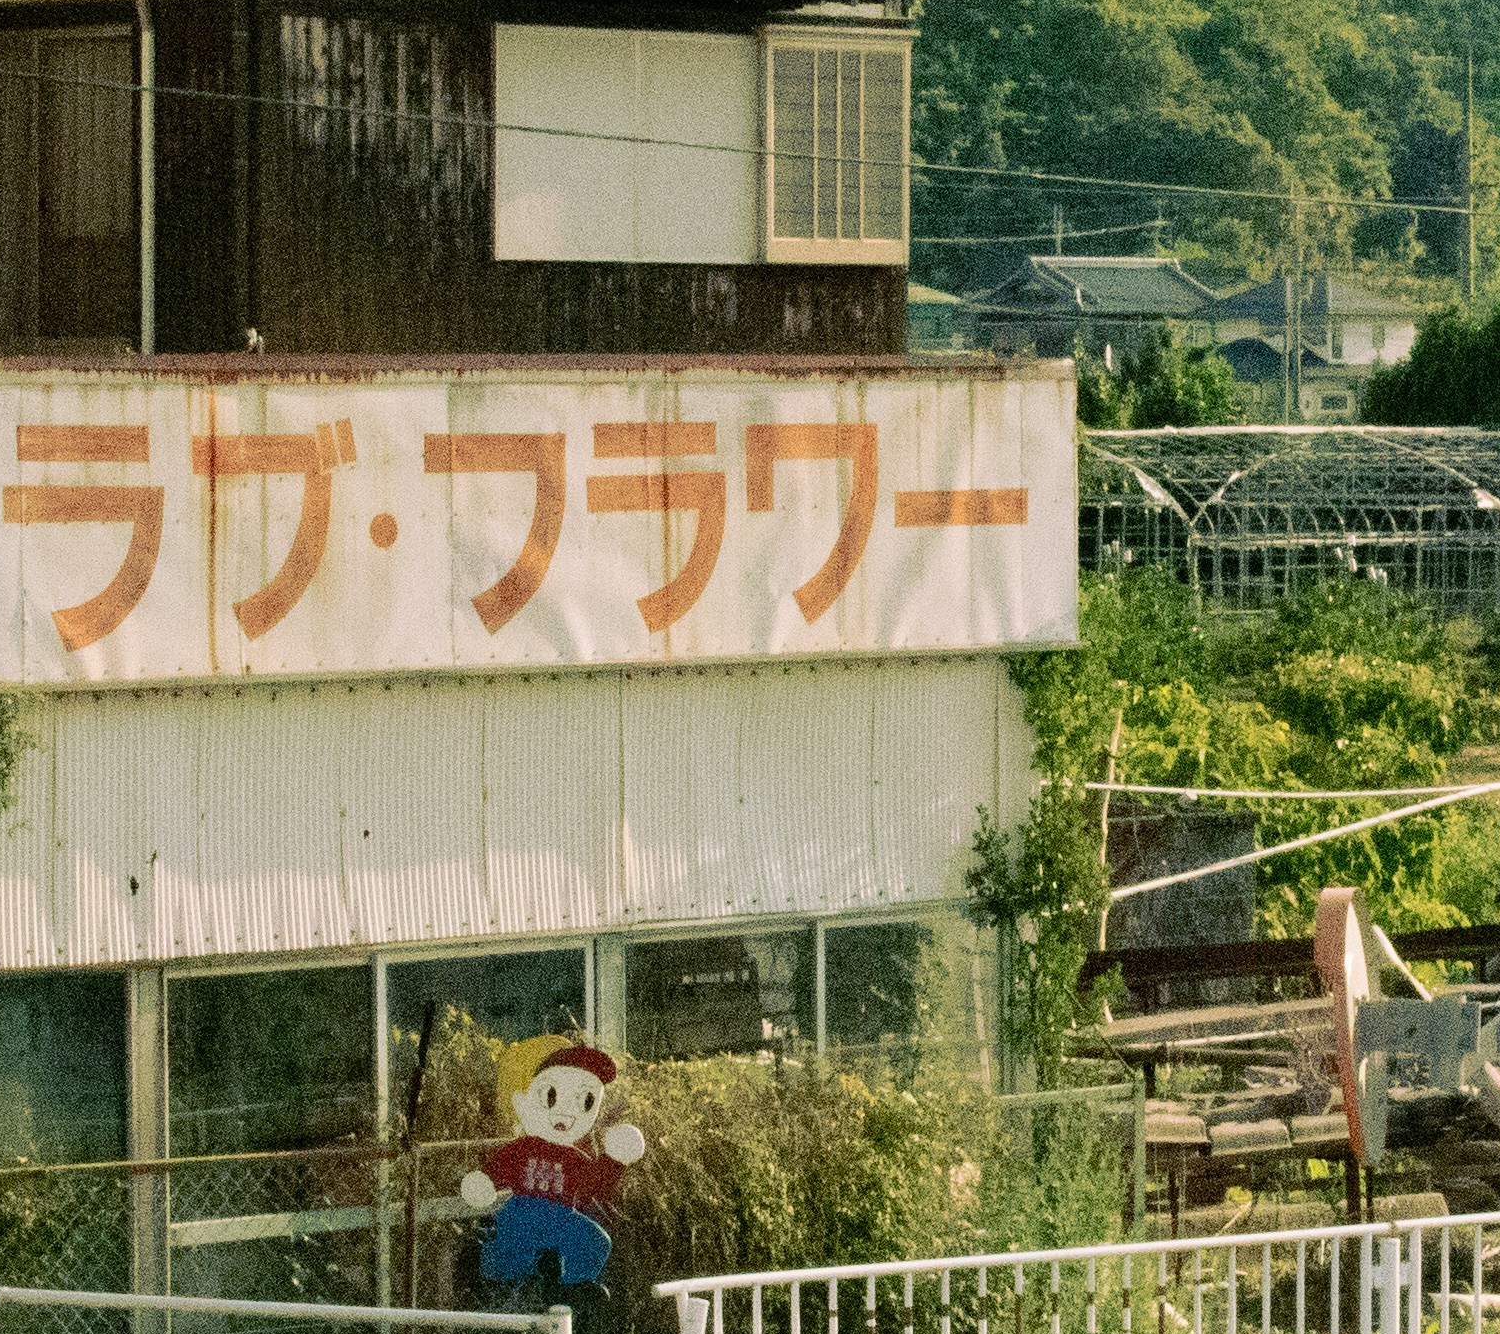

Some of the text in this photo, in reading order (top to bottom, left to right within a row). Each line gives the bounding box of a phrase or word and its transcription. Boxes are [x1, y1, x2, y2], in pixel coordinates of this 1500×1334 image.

[2, 417, 1029, 653] ラブ・フラワー
